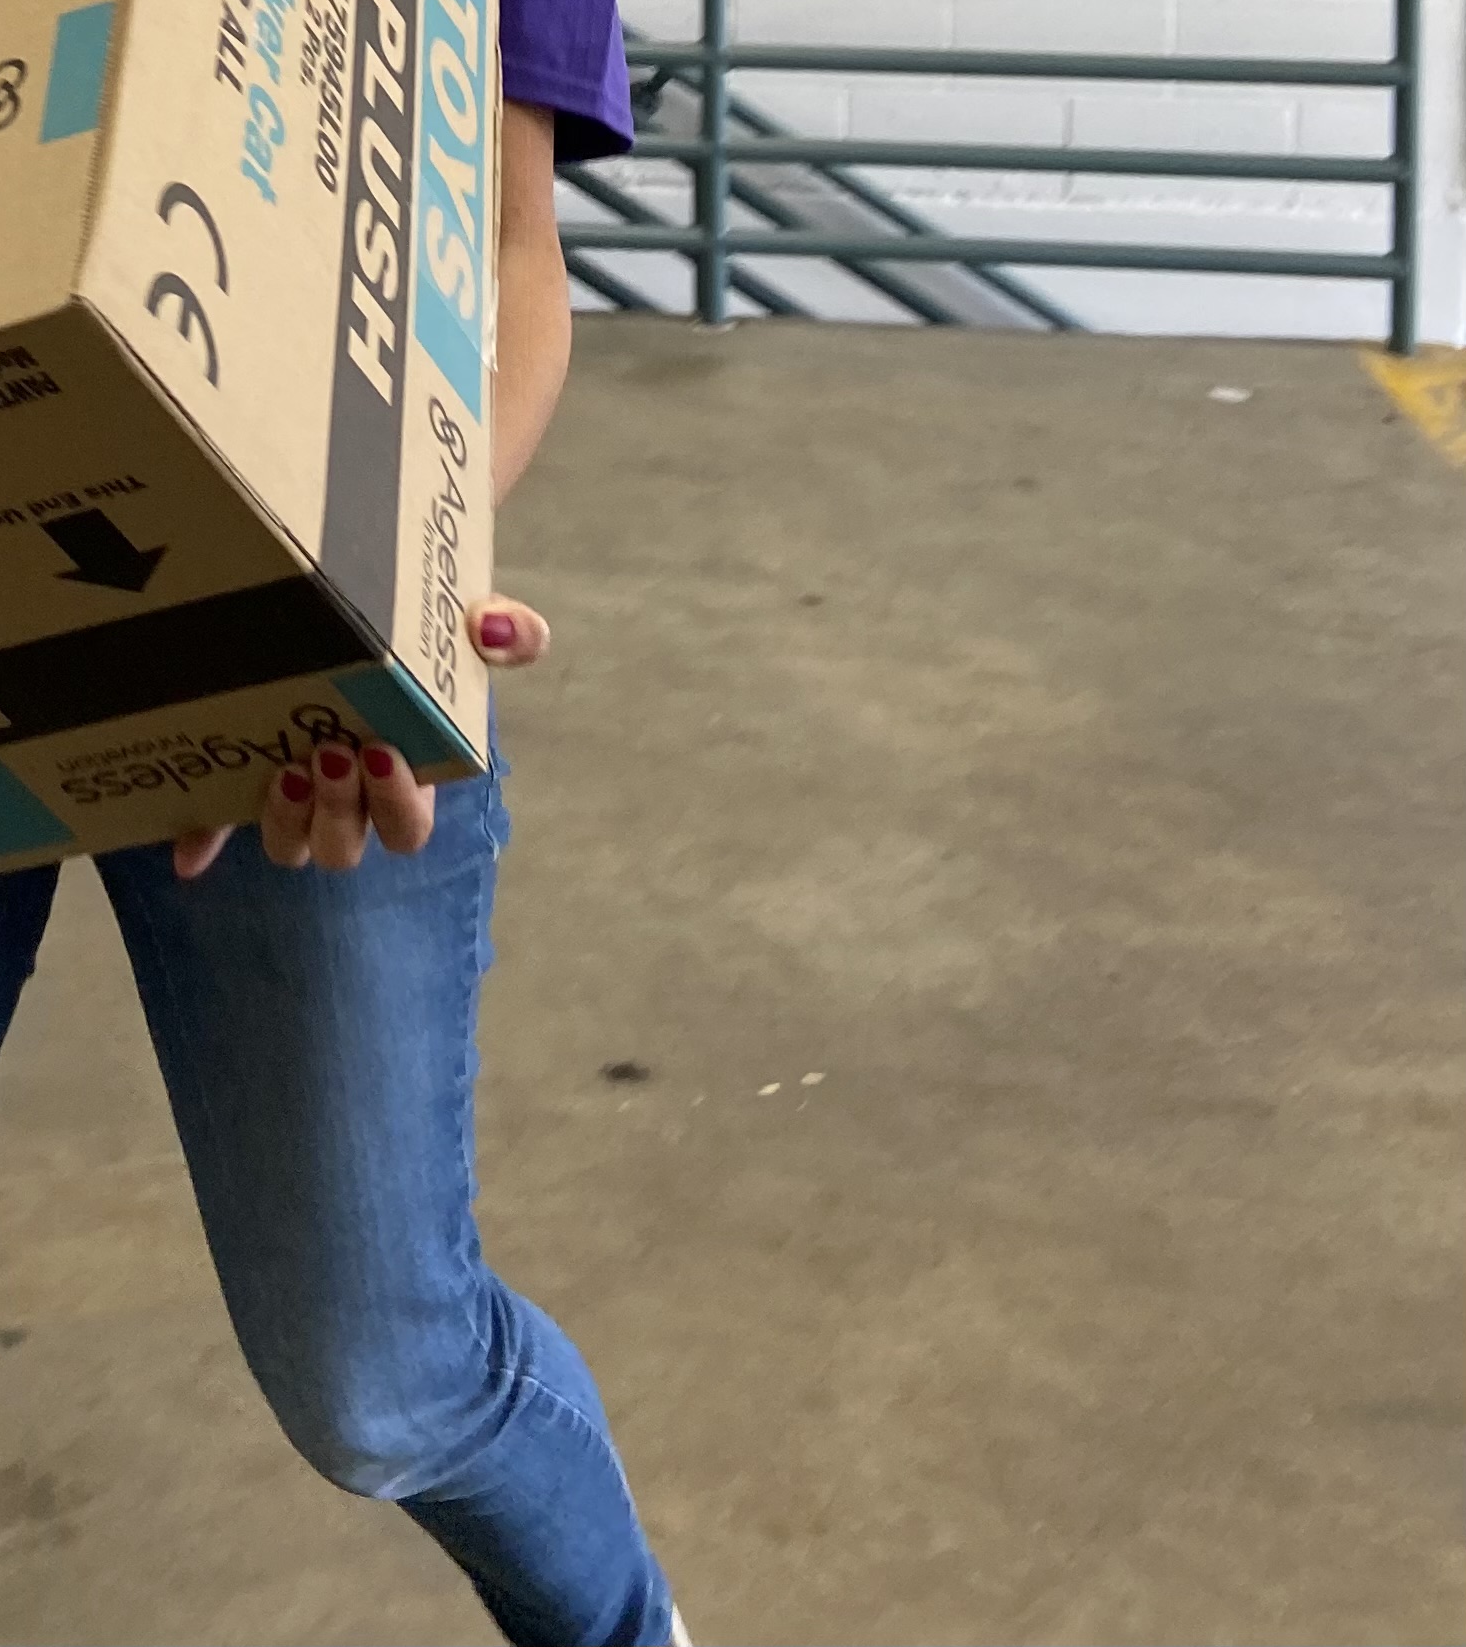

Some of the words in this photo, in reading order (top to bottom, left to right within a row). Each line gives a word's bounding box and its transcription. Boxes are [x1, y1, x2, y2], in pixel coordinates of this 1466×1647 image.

[240, 83, 287, 208] Cat
[83, 474, 148, 501] This
[433, 454, 467, 708] Ageless
[60, 728, 294, 805] Ageless
